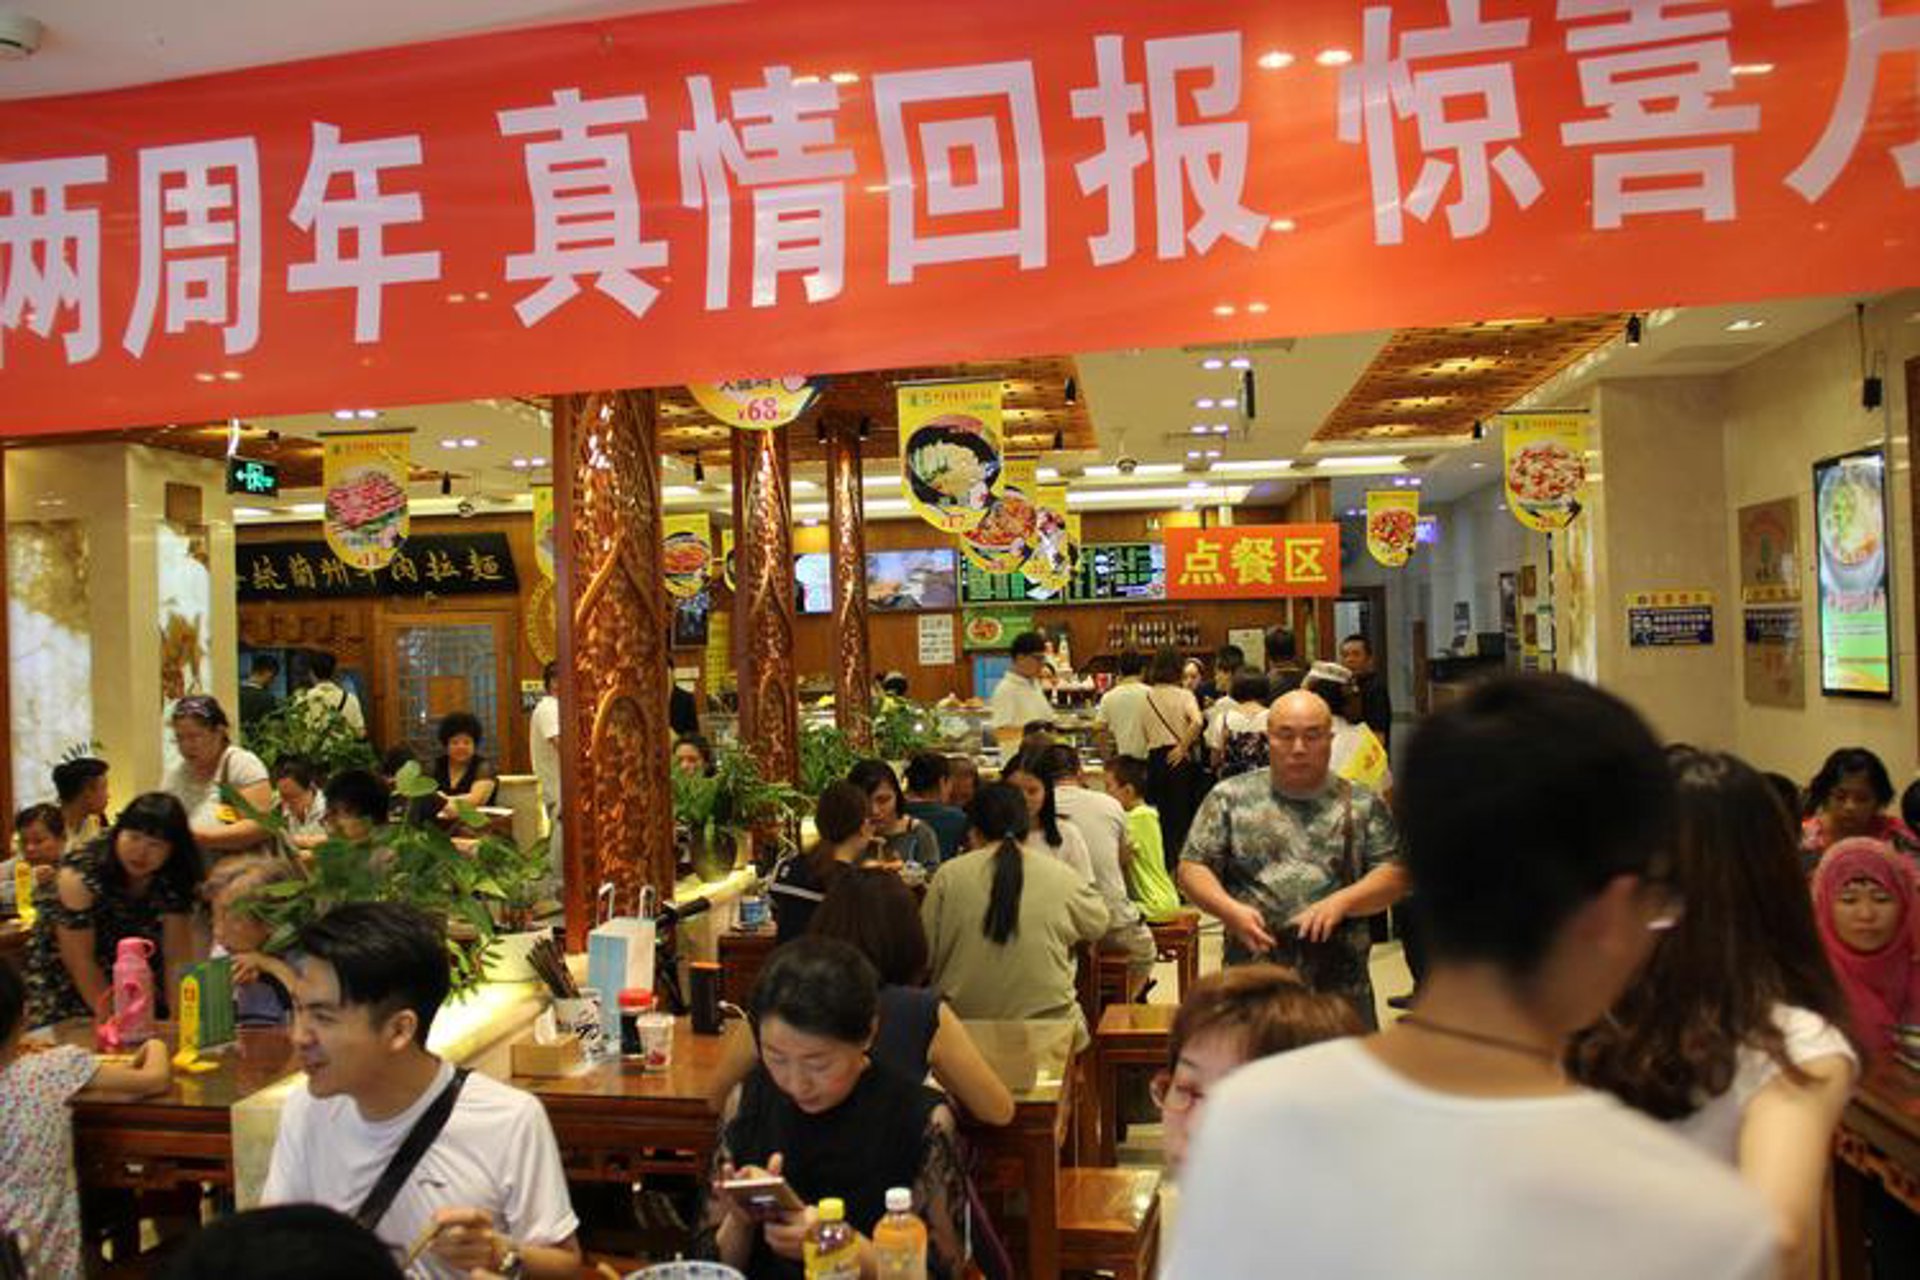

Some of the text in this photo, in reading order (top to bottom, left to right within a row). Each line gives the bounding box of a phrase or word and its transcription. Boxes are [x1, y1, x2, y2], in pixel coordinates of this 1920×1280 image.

[0, 122, 441, 369] 两周年
[497, 30, 1270, 328] 真情回报
[1178, 537, 1328, 585] 点餐区
